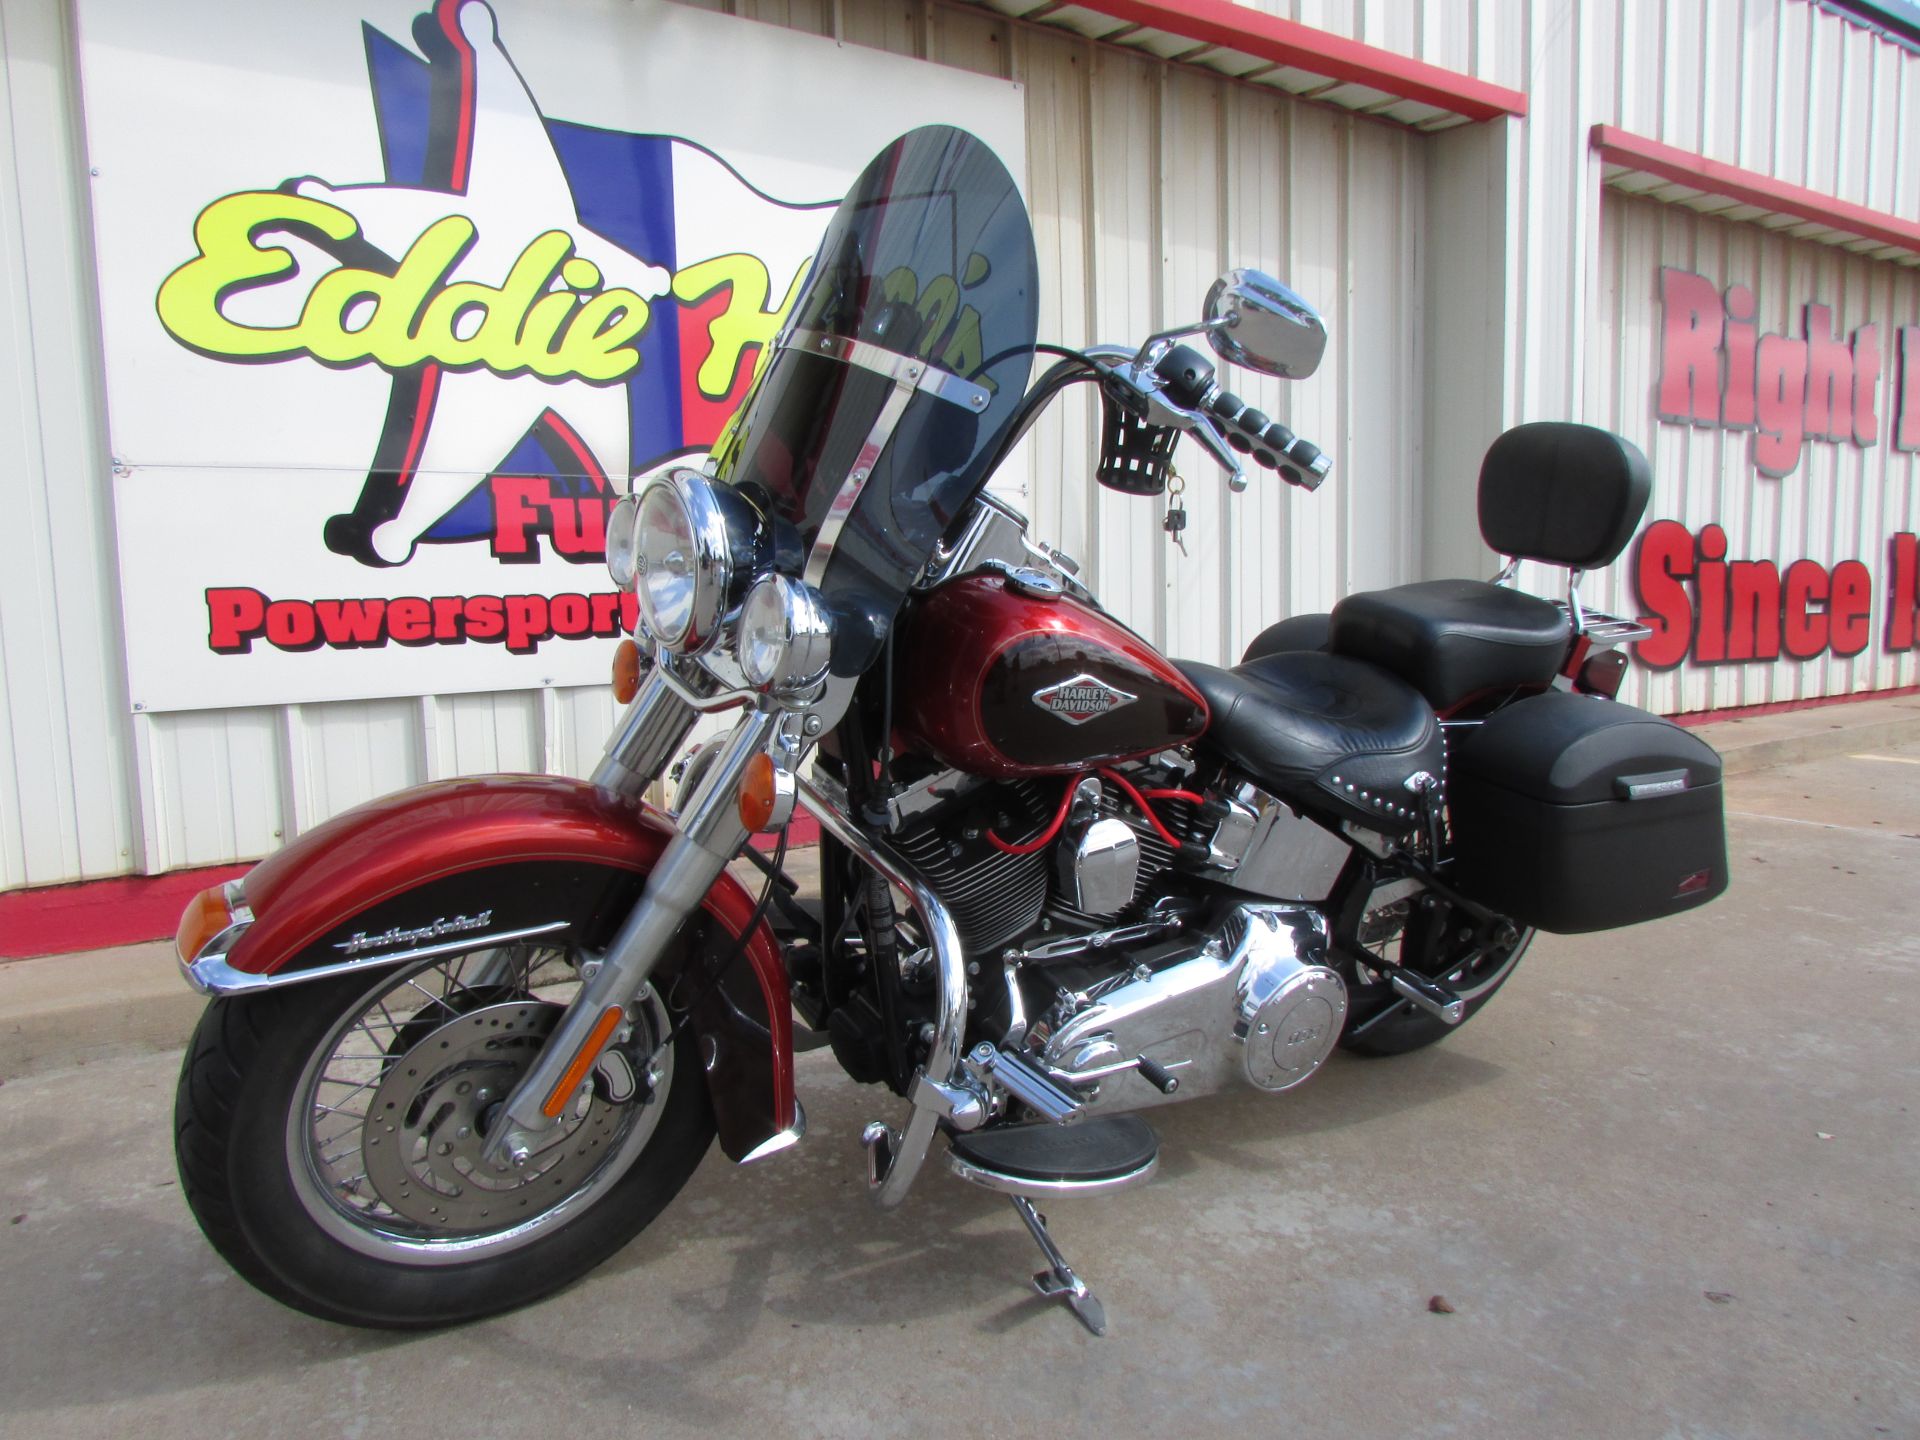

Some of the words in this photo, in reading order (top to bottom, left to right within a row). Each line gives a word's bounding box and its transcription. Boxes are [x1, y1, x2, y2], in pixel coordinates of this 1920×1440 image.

[156, 189, 651, 387] Eddie
[1658, 265, 1881, 478] Right
[1634, 519, 1872, 672] Since
[1051, 699, 1110, 712] DAVIDSON
